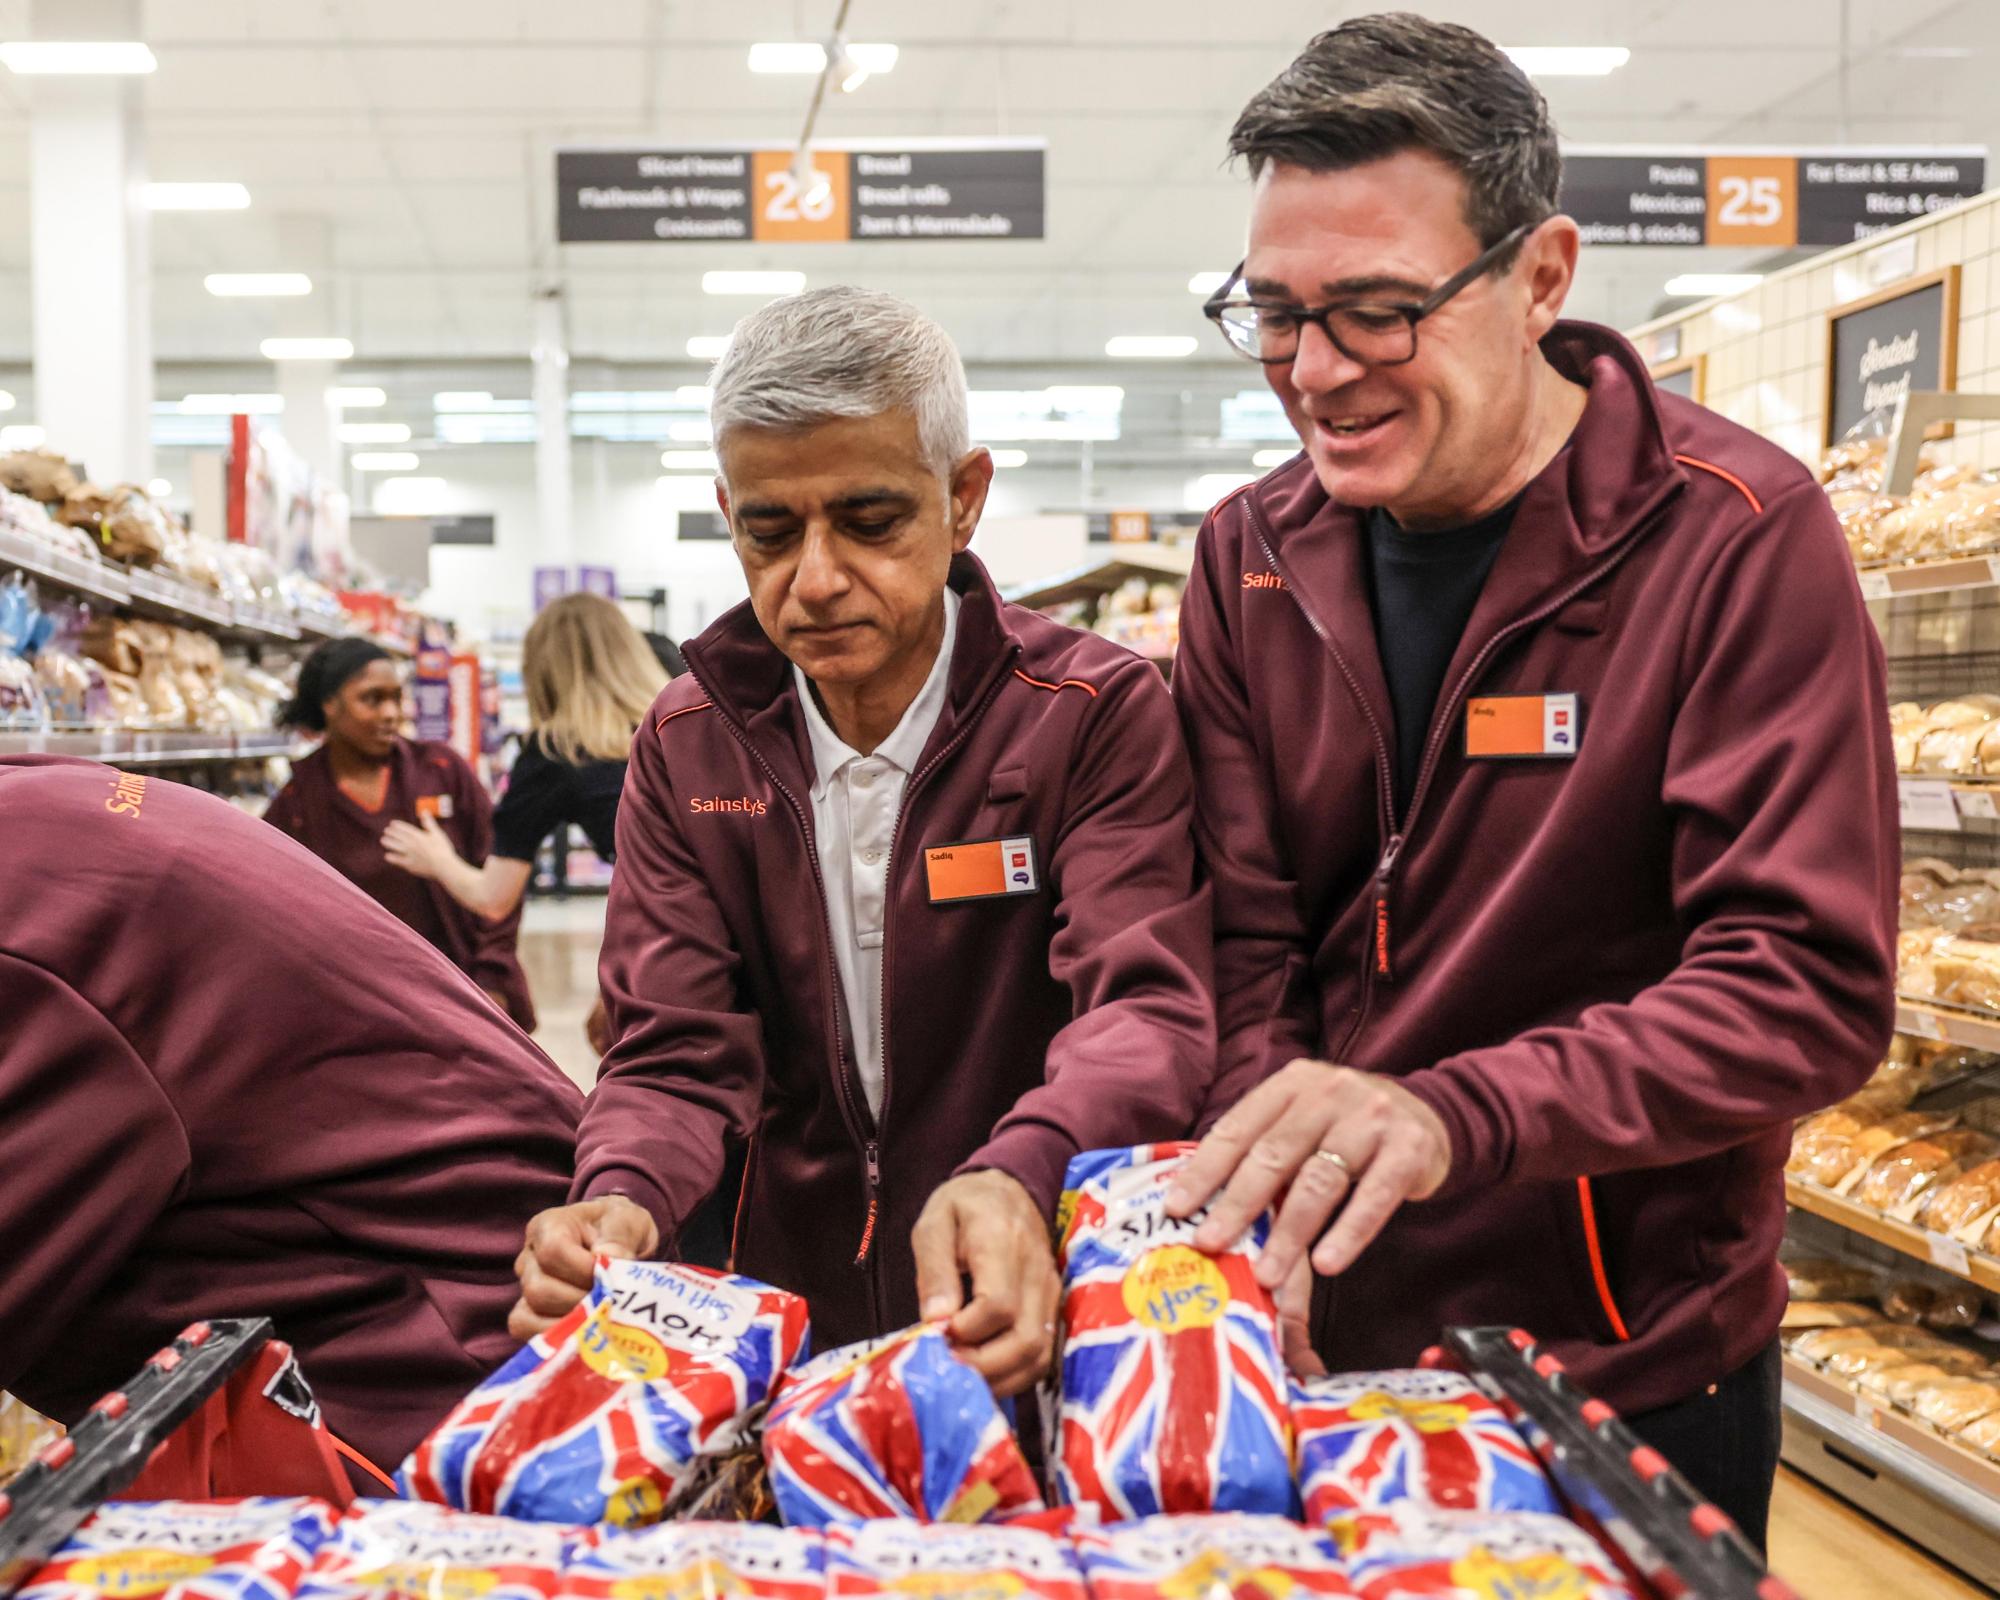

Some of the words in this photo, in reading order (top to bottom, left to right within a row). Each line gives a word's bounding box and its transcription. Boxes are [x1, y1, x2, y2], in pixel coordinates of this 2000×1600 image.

[693, 155, 745, 177] bread
[858, 155, 911, 175] Bread
[1649, 165, 1698, 184] Pasta
[1873, 163, 1887, 182] &
[670, 186, 687, 208] &
[858, 185, 909, 206] Bread
[1630, 193, 1705, 213] Mexican
[1718, 176, 1783, 226] 25
[897, 215, 911, 235] &
[913, 214, 1012, 235] Marmalade
[1627, 223, 1643, 243] &
[1242, 571, 1291, 592] Sain
[930, 852, 954, 861] Sadiq
[627, 1263, 687, 1298] White
[684, 1290, 734, 1322] Soft
[1147, 1283, 1220, 1324] Soft
[604, 1289, 722, 1348] HOVIS
